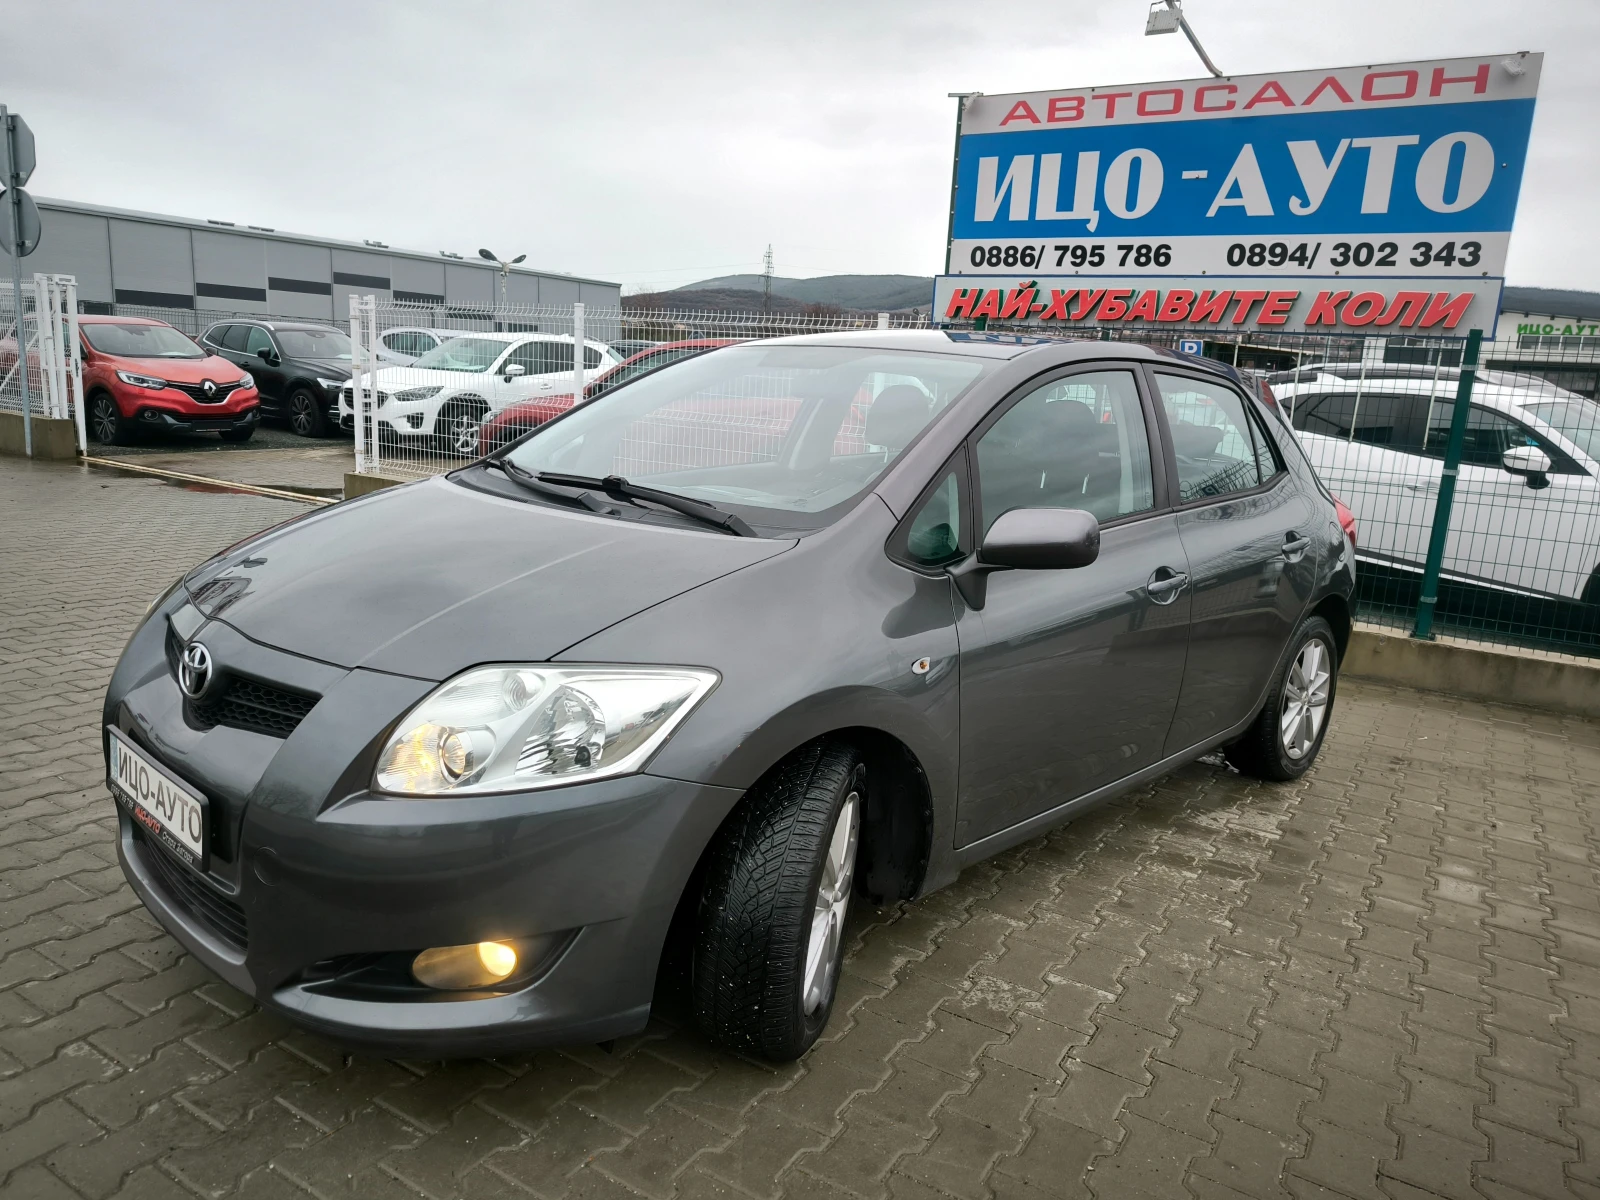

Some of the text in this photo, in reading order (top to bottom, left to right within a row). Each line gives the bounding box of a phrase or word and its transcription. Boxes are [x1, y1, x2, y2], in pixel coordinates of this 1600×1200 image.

[999, 64, 1490, 126] АВТОСАЛОН
[970, 244, 1172, 269] 0886/ 795 786
[1226, 241, 1482, 269] 0894/ 302 343
[945, 280, 1476, 328] НАЙ-ХУБАВИТЕ КОЛИ
[1517, 324, 1600, 336] ИЦО-АУТ
[119, 747, 201, 843] ИЦО-АУТО
